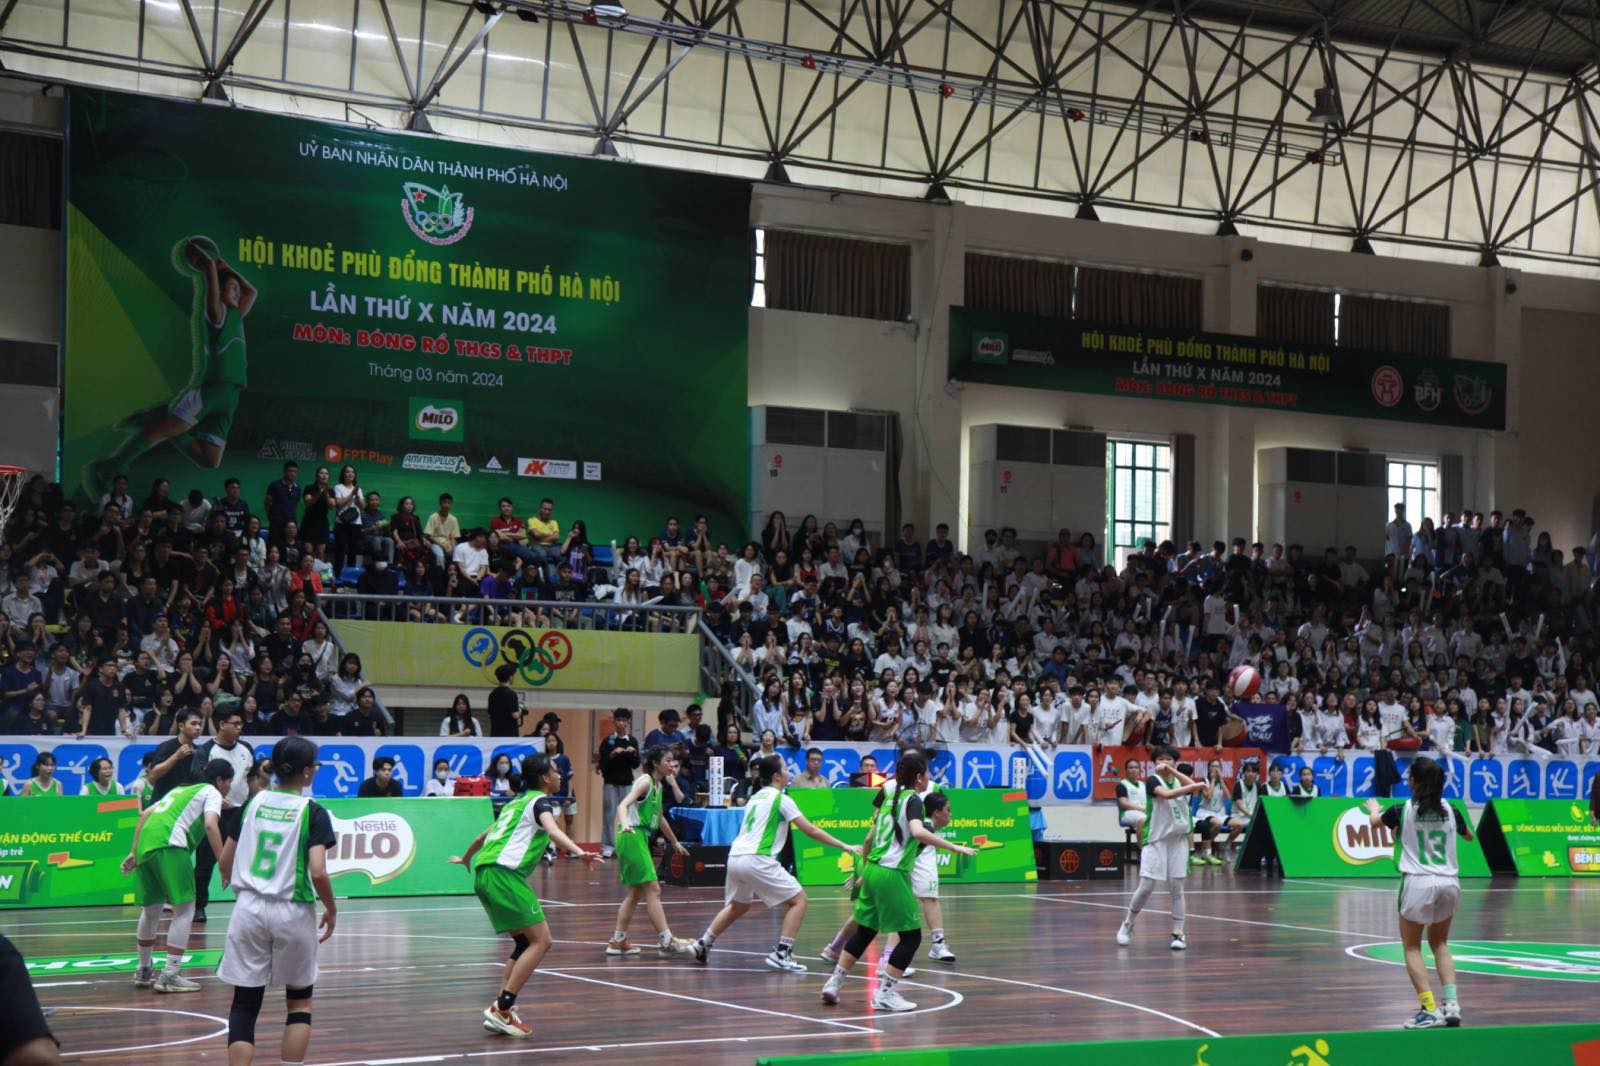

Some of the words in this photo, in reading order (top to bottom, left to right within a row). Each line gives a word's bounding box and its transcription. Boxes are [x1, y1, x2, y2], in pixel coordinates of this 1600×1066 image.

[300, 140, 318, 157] UỶ
[322, 147, 354, 162] BAN
[356, 148, 399, 169] NHÂN
[402, 153, 434, 174] DÂN
[438, 160, 484, 180] THÀNH
[487, 165, 517, 185] PHỐ
[520, 169, 539, 188] HÀ
[543, 173, 568, 191] NỘI
[239, 236, 274, 270] HỘI
[282, 242, 335, 273] KHOẺ
[342, 249, 381, 279] PHÙ
[388, 249, 442, 285] ĐỔNG
[449, 263, 510, 292] THÀNH
[516, 265, 554, 296] PHỐ
[559, 273, 584, 299] HÀ
[589, 276, 621, 306] NỘI
[310, 282, 357, 316] LẦN
[365, 295, 411, 321] THỨ
[417, 302, 435, 323] X
[442, 302, 496, 329] NĂM
[502, 311, 558, 335] 2024
[292, 323, 352, 347] MÔN:
[356, 329, 416, 353] BÓNG
[421, 333, 450, 356] RỔ
[454, 340, 502, 360] THCS
[506, 344, 523, 362] &
[526, 346, 573, 366] THPT
[981, 342, 1002, 352] MILO
[1081, 331, 1105, 354] HỘI
[1109, 334, 1142, 354] KHOẺ
[1147, 337, 1173, 357] PHÙ
[1177, 336, 1212, 360] ĐỔNG
[1216, 342, 1256, 365] THÀNH
[1261, 345, 1285, 367] PHỐ
[1288, 349, 1306, 369] HÀ
[1310, 353, 1330, 375] NỘI
[367, 362, 412, 383] Tháng
[415, 367, 433, 382] 03
[436, 368, 469, 385] năm
[472, 371, 504, 388] 2024
[1133, 356, 1161, 377] LẦN
[1164, 363, 1193, 379] THỨ
[1196, 366, 1207, 380] X
[1211, 366, 1244, 384] NĂM
[1248, 371, 1282, 387] 2024
[422, 412, 454, 426] MILO
[343, 448, 366, 461] FPT
[368, 450, 395, 465] Play
[745, 804, 757, 833] 4
[839, 819, 861, 829] MILO
[862, 816, 875, 829] MỖ
[954, 818, 978, 829] ĐỘNG
[995, 817, 1015, 828] CHẤT
[1535, 825, 1551, 833] MILO
[21, 832, 57, 846] ĐỘNG
[83, 830, 113, 842] CHẤT
[1345, 824, 1397, 848] MIL
[1415, 829, 1448, 865] 13
[10, 847, 24, 856] trẻ
[249, 830, 284, 880] 6
